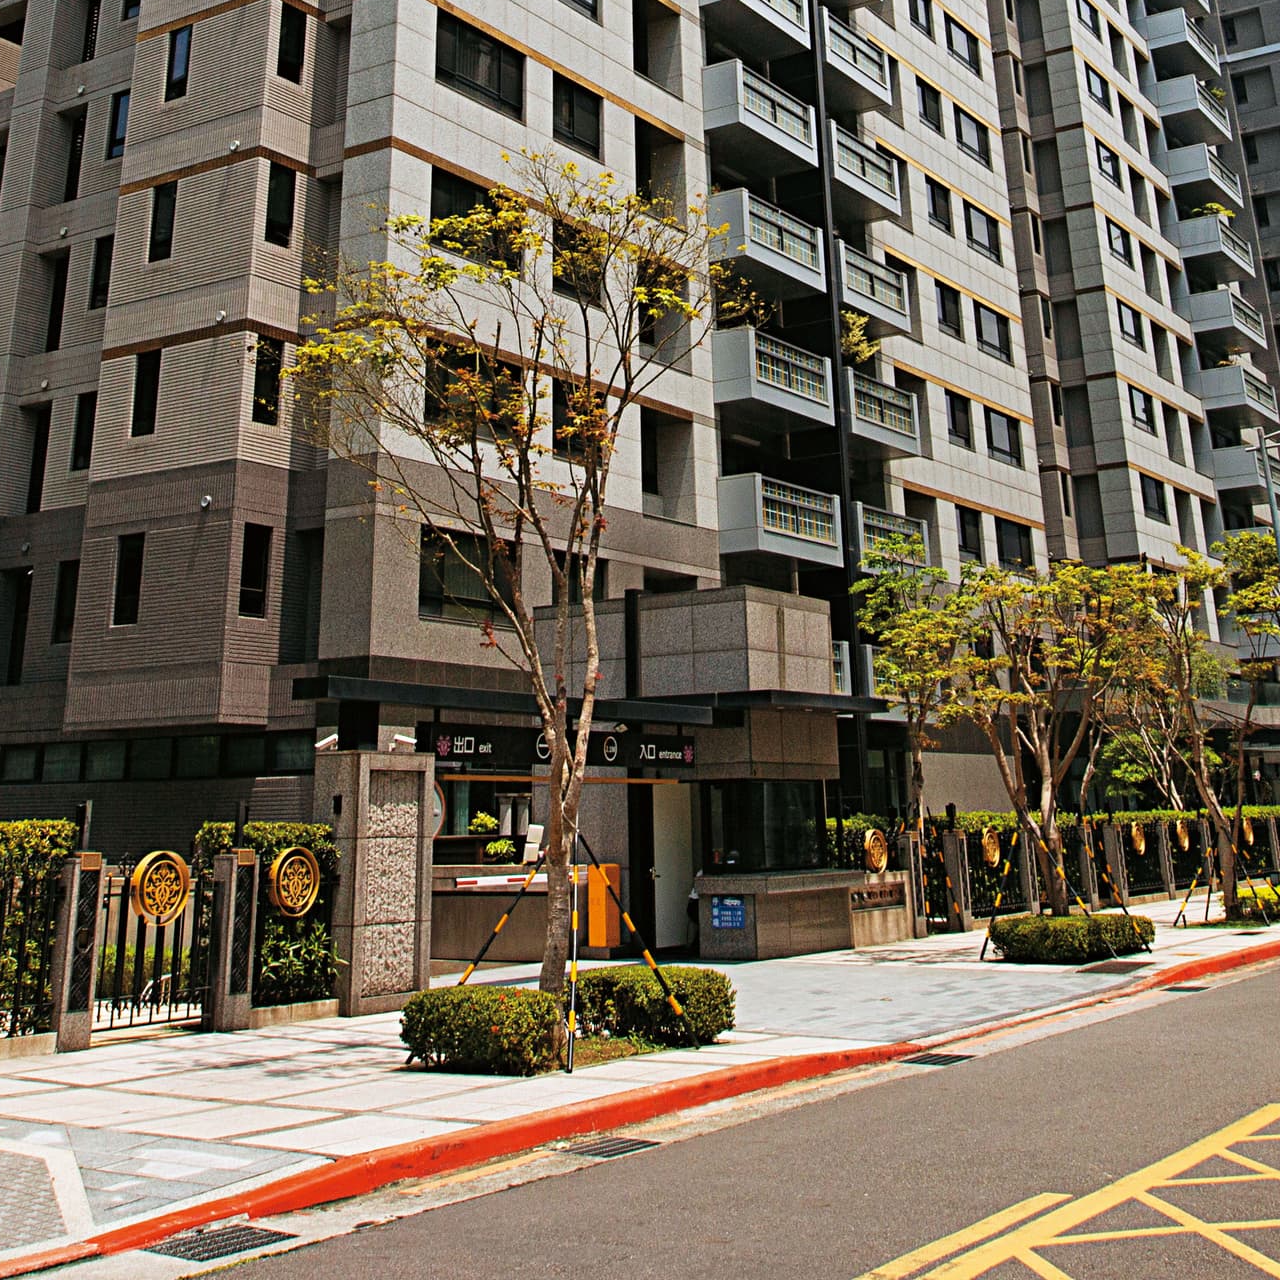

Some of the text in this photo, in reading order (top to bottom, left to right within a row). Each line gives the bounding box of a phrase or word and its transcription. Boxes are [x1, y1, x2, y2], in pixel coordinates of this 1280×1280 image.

[453, 736, 475, 753] 出口
[478, 742, 492, 753] exit
[640, 744, 656, 759] 入口
[658, 750, 682, 760] entrance
